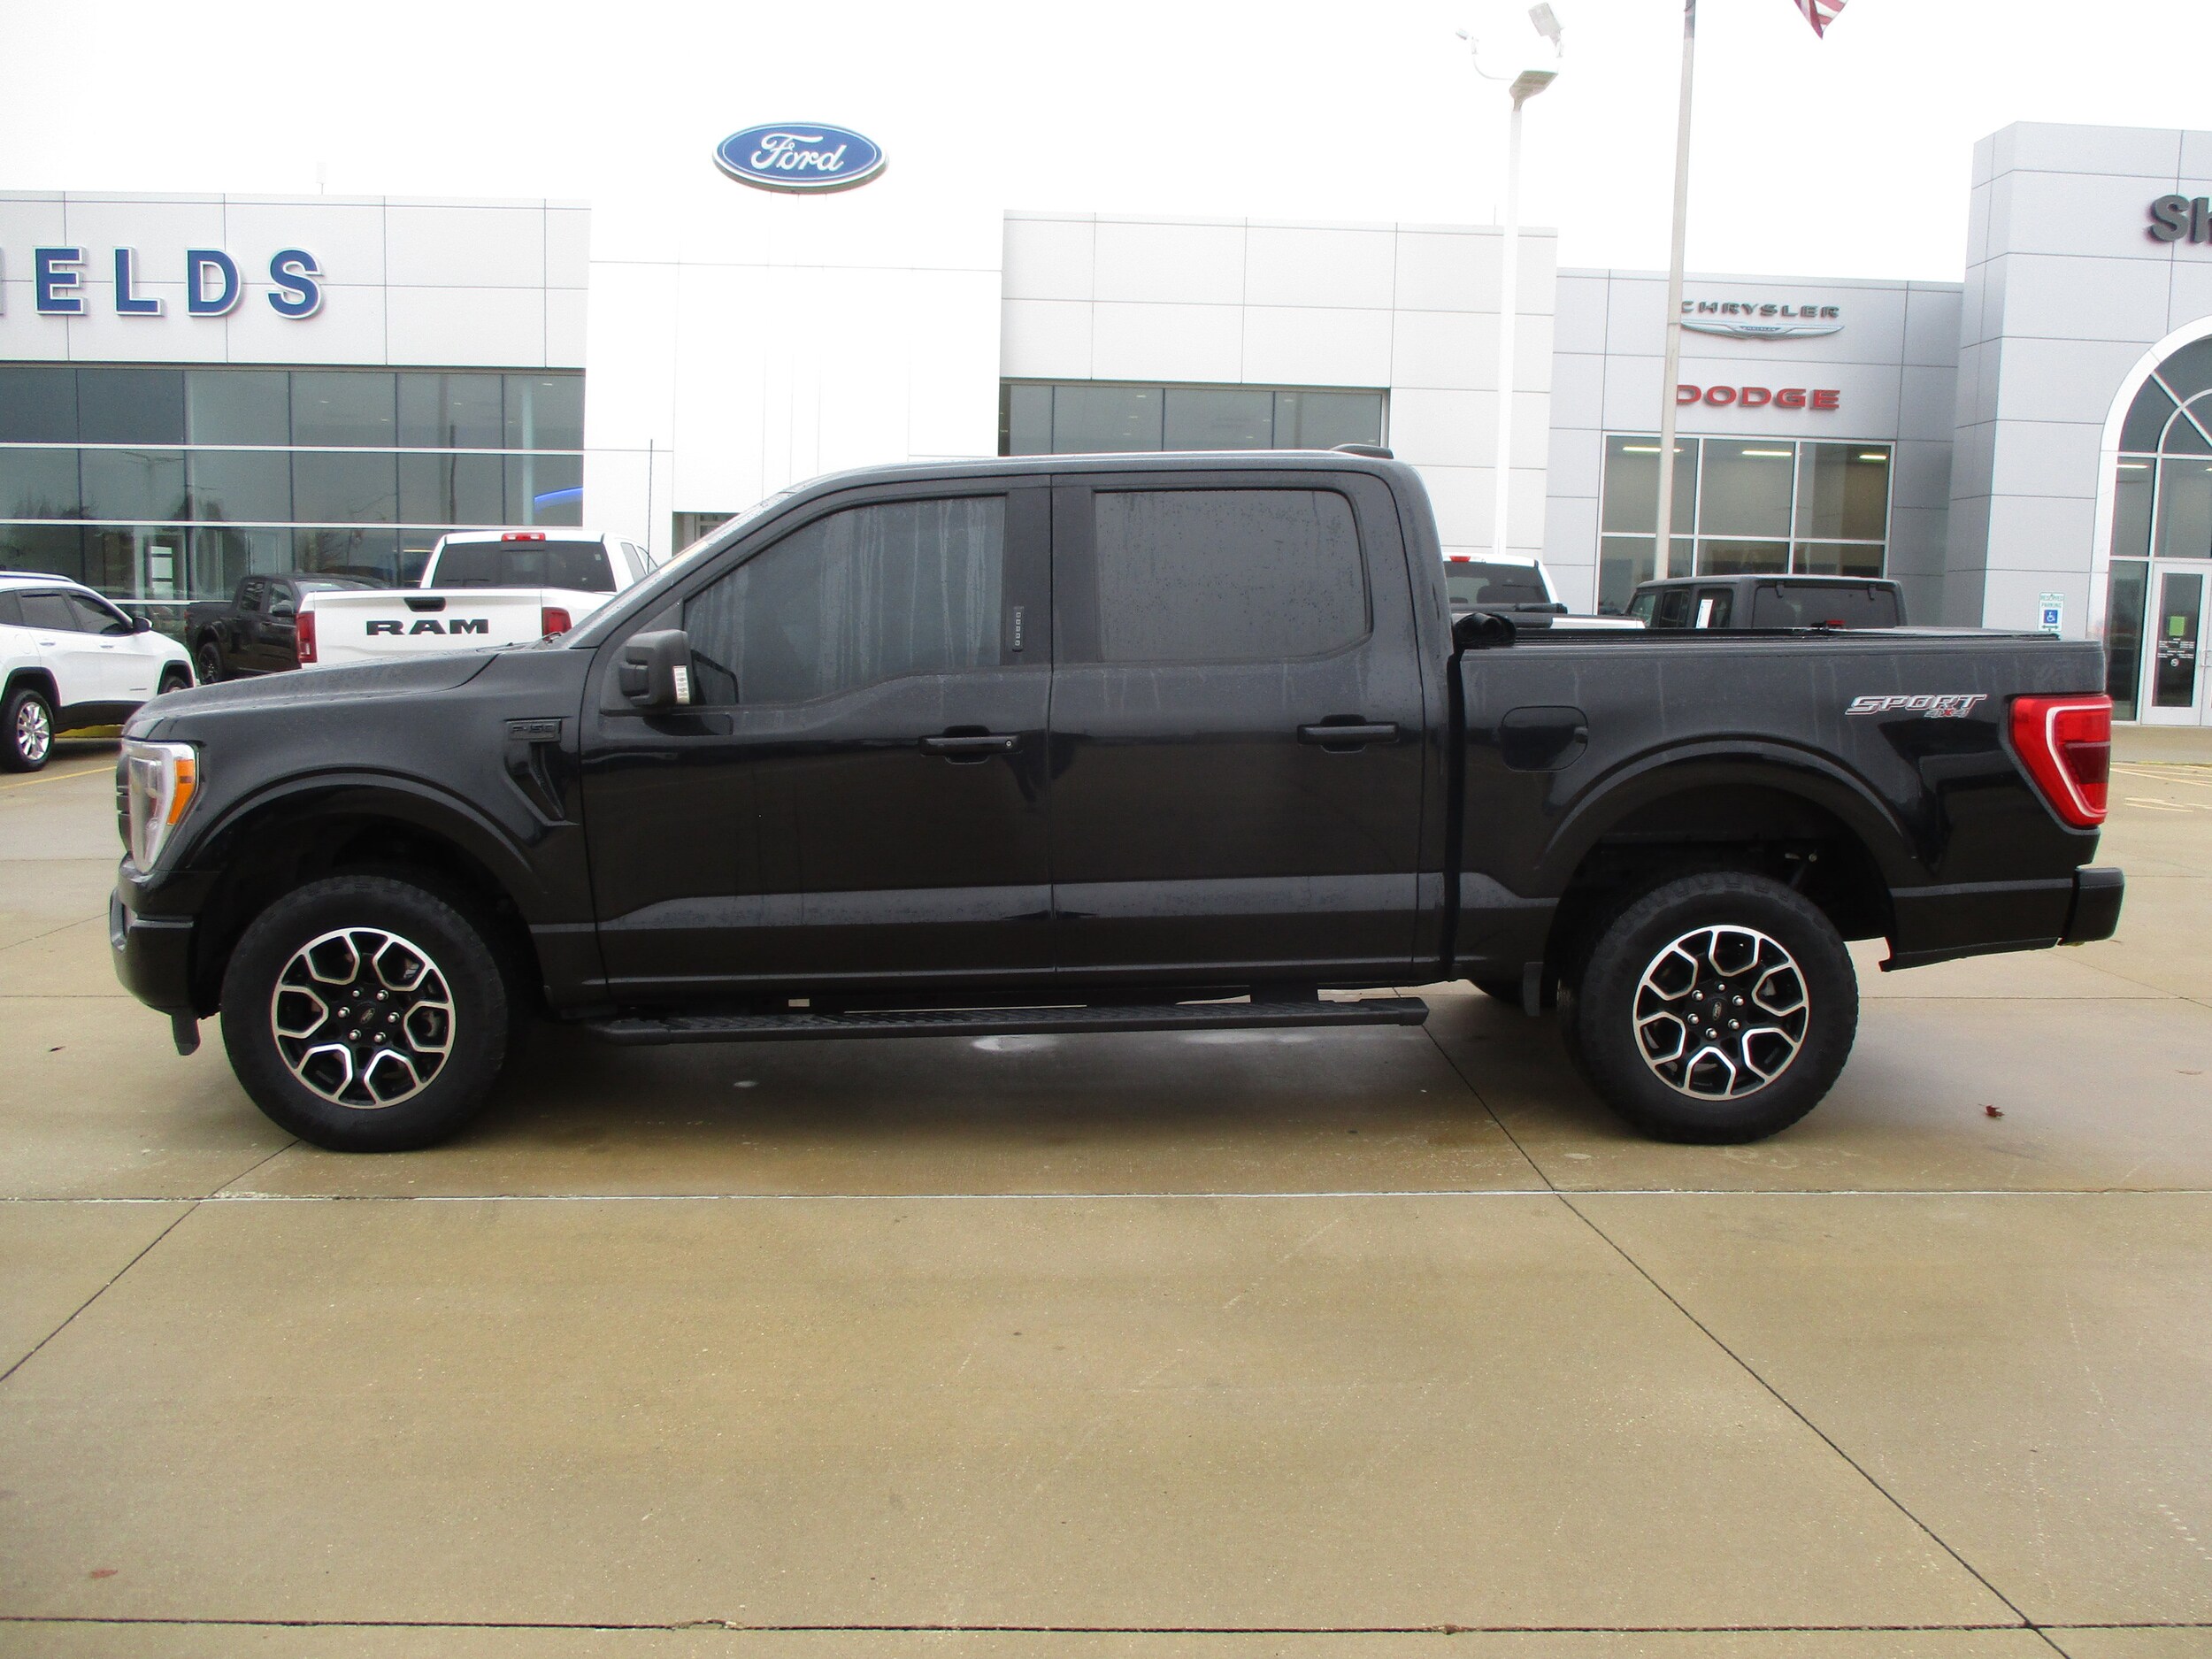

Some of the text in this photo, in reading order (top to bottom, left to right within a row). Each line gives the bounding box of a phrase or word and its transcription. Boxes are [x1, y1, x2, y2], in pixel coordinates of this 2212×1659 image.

[751, 134, 848, 172] Ford
[0, 246, 323, 319] ELDS
[1681, 300, 1840, 319] CHRYSLER
[1677, 384, 1840, 410] DODGE
[366, 618, 488, 635] RAM
[1845, 694, 1987, 715] SPORT
